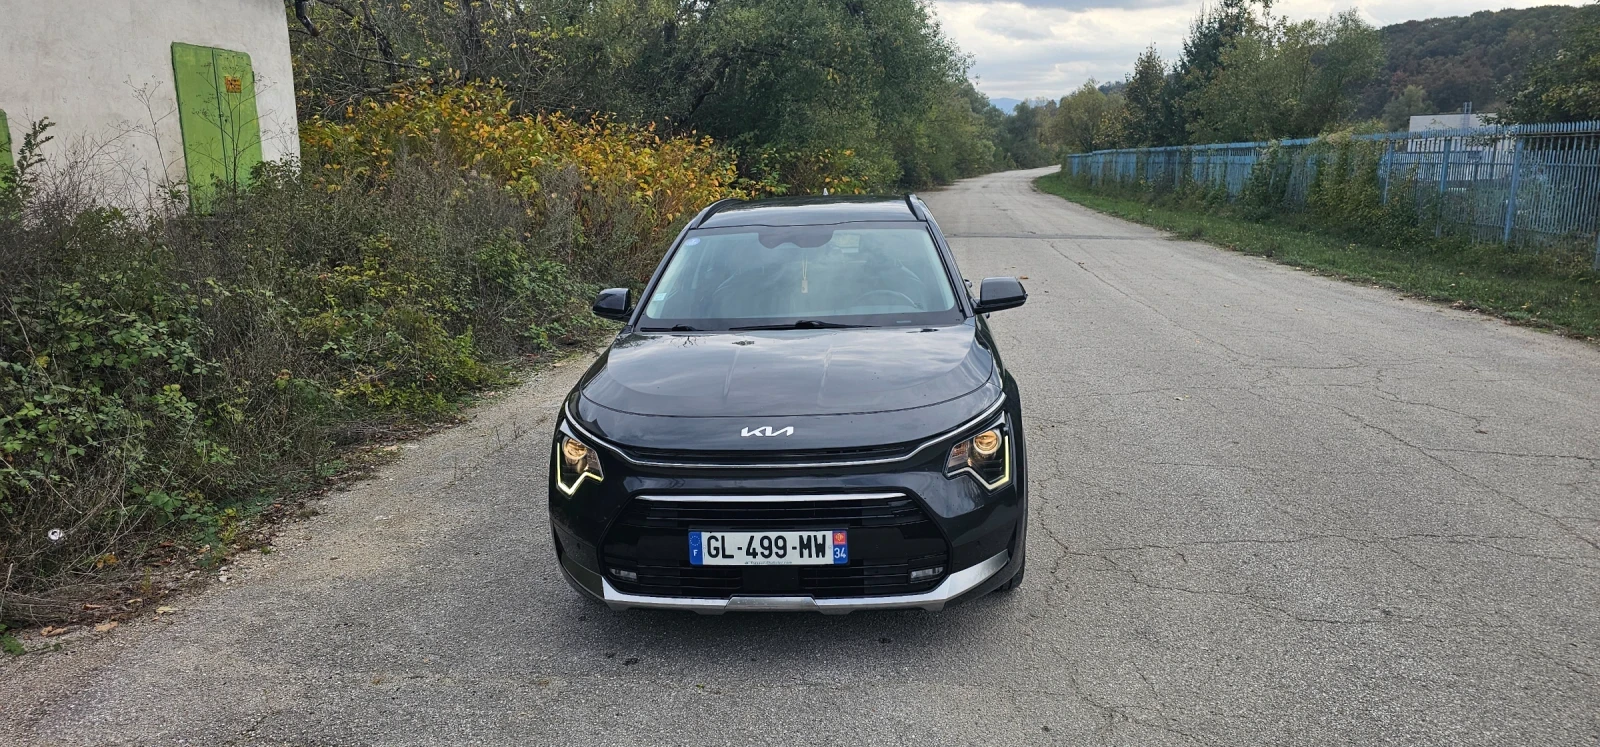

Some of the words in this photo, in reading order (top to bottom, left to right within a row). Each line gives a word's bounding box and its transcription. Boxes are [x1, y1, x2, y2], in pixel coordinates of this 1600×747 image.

[706, 534, 826, 559] GL-499-MW
[693, 549, 698, 557] F
[834, 547, 847, 559] 34
